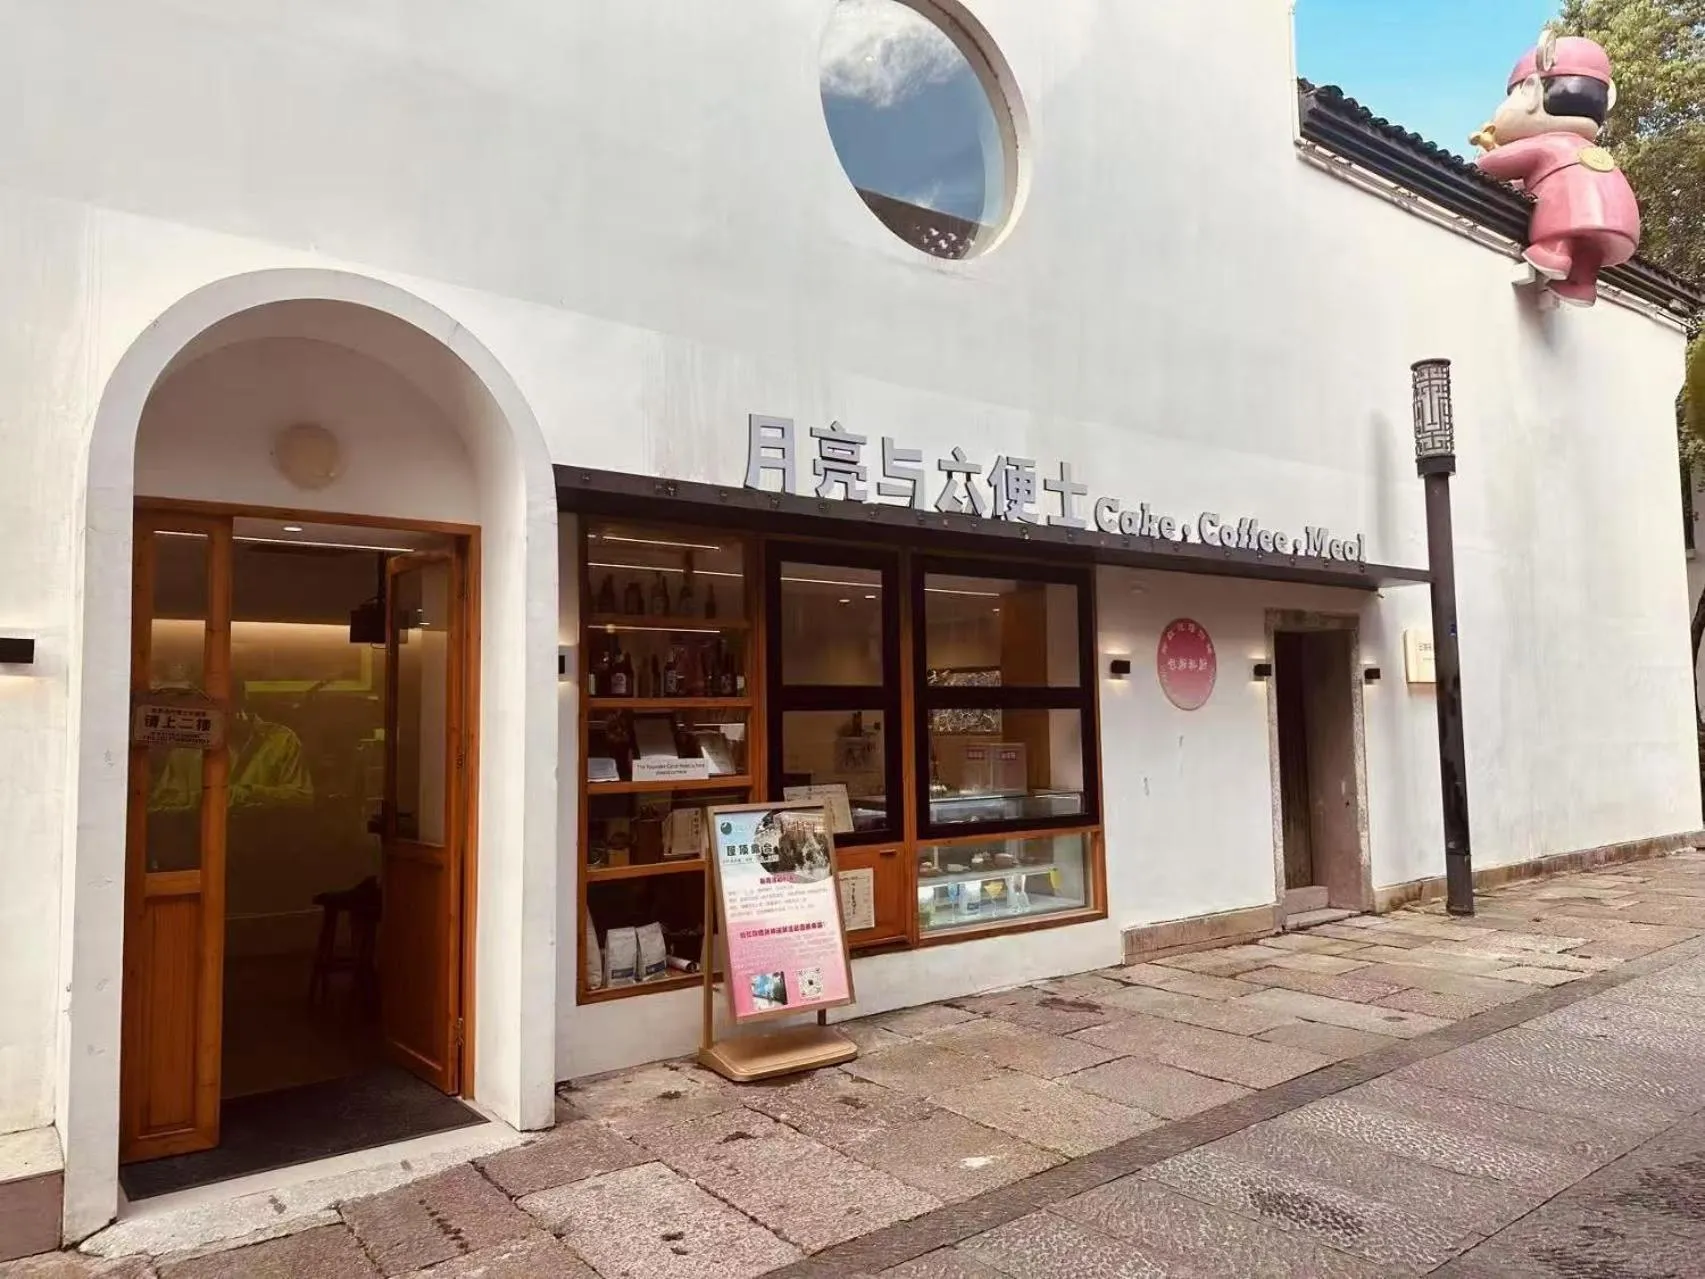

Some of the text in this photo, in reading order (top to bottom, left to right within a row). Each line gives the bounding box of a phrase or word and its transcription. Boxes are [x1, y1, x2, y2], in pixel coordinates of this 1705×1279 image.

[744, 413, 1088, 529] 月亮与六便士
[1305, 525, 1366, 562] Meal
